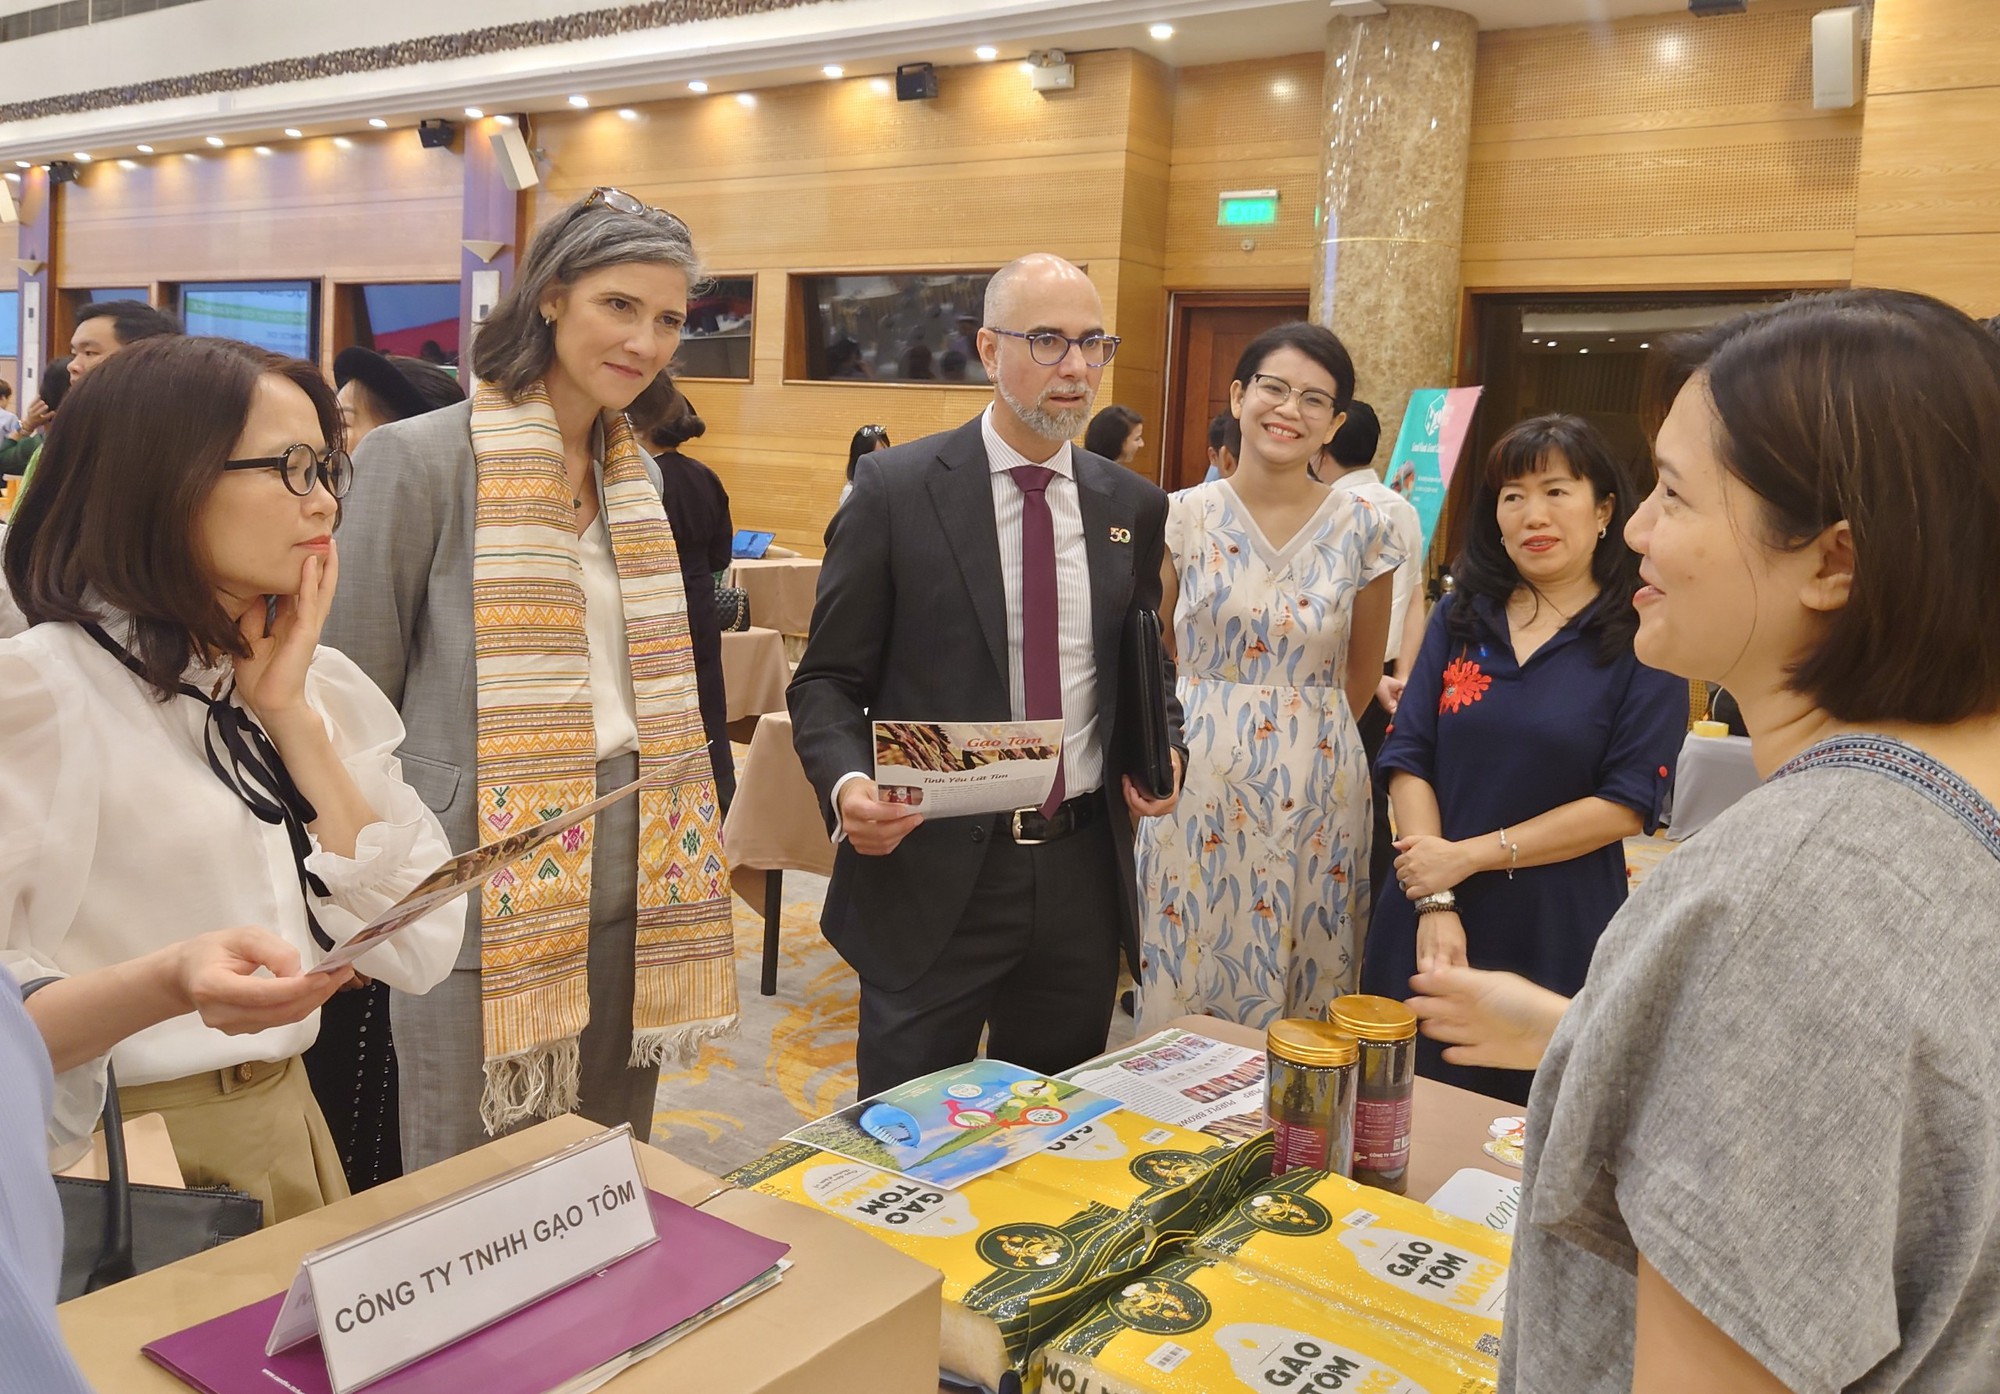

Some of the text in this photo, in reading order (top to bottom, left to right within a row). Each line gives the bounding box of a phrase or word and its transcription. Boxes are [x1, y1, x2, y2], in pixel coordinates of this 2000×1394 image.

[1205, 1099, 1237, 1116] PURPLE
[334, 1179, 637, 1334] CÔNG TY TNHH GẠO TÔM
